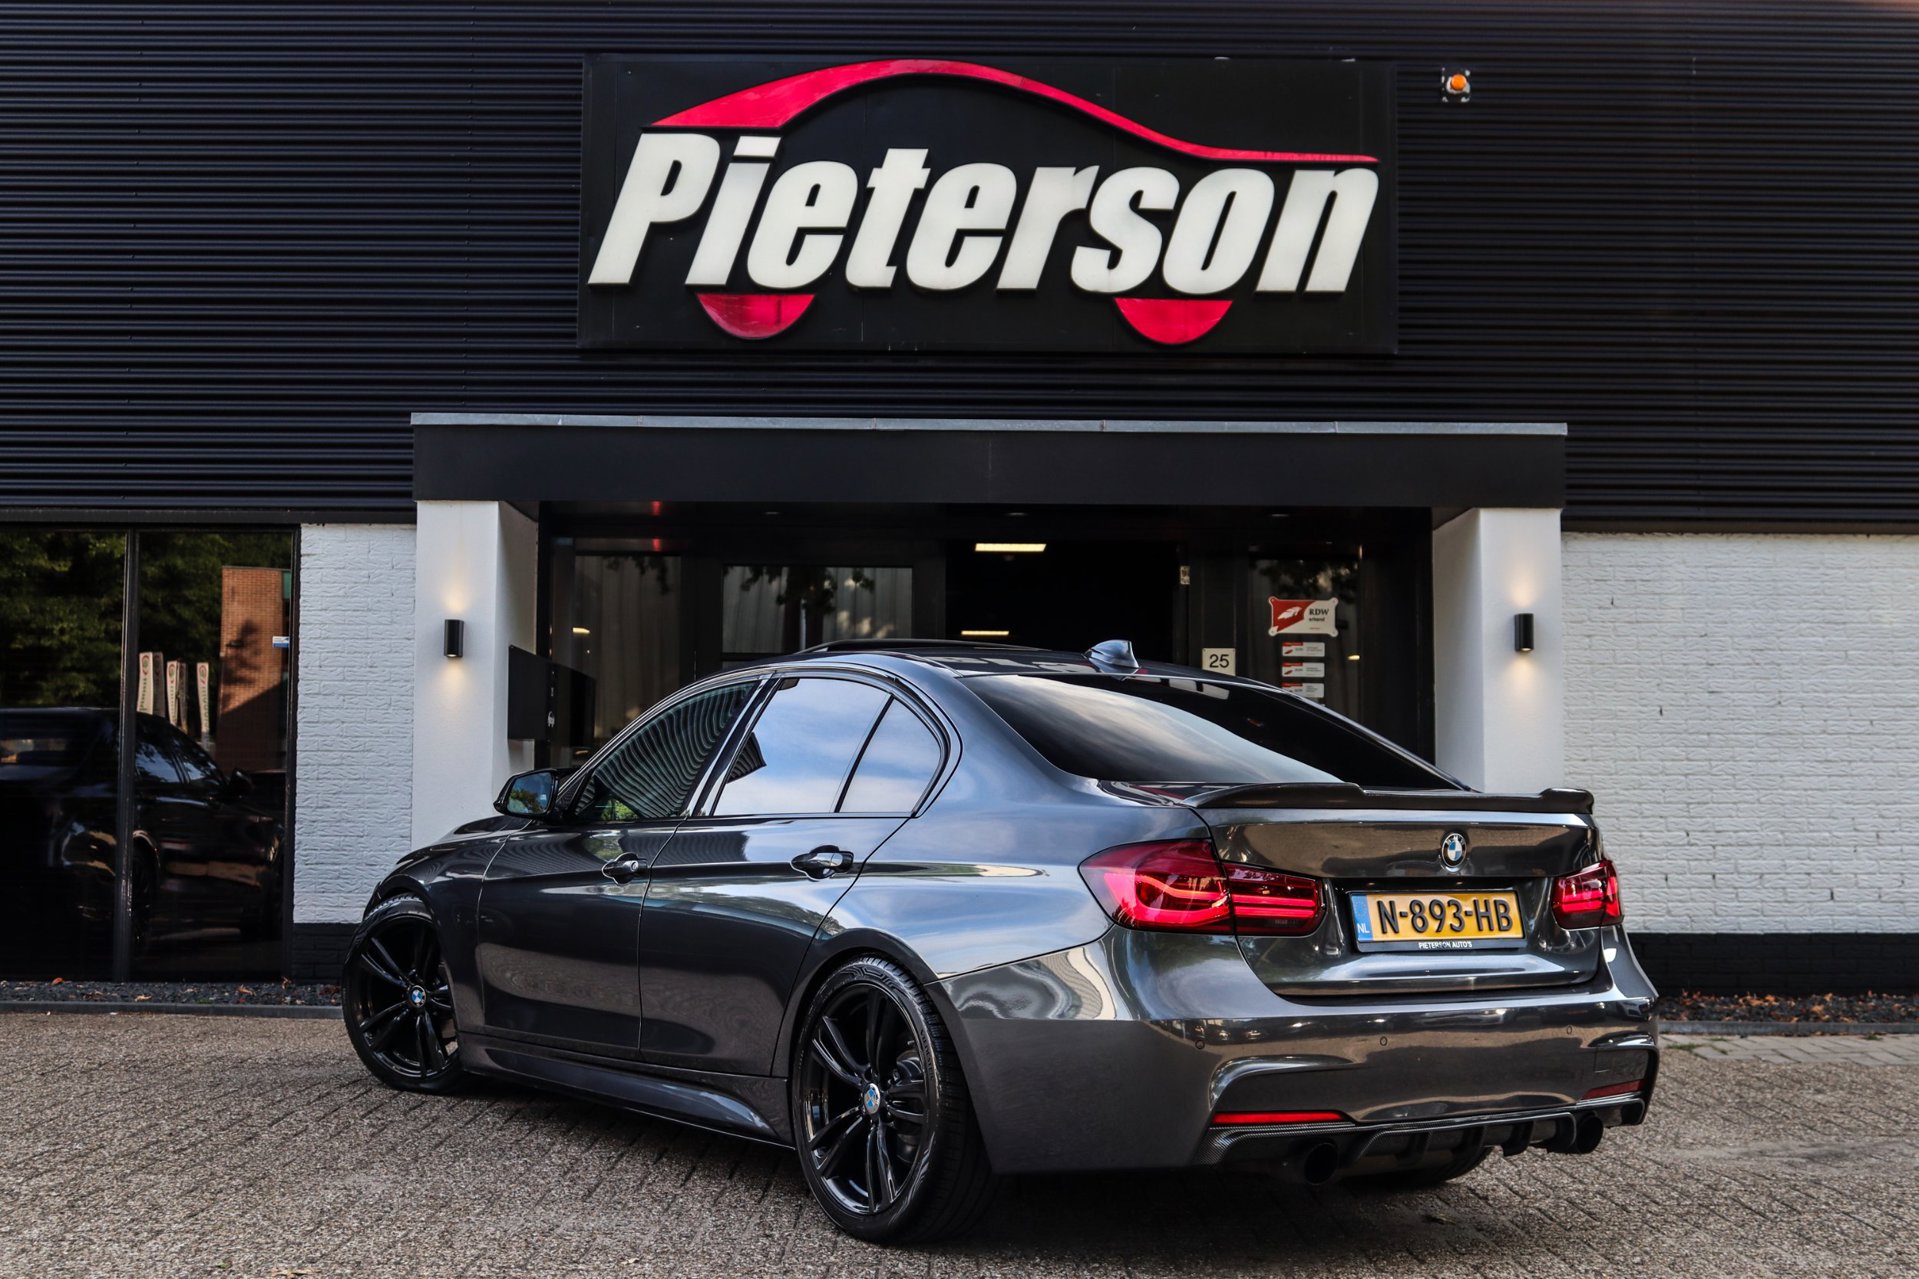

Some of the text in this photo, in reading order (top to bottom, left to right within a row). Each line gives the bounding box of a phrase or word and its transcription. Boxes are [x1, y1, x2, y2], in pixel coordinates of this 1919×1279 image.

[588, 132, 1380, 295] Pieterson
[1309, 608, 1329, 616] RDW
[1209, 654, 1230, 668] 25
[1377, 899, 1513, 934] N-893-HB
[1357, 923, 1370, 934] NL
